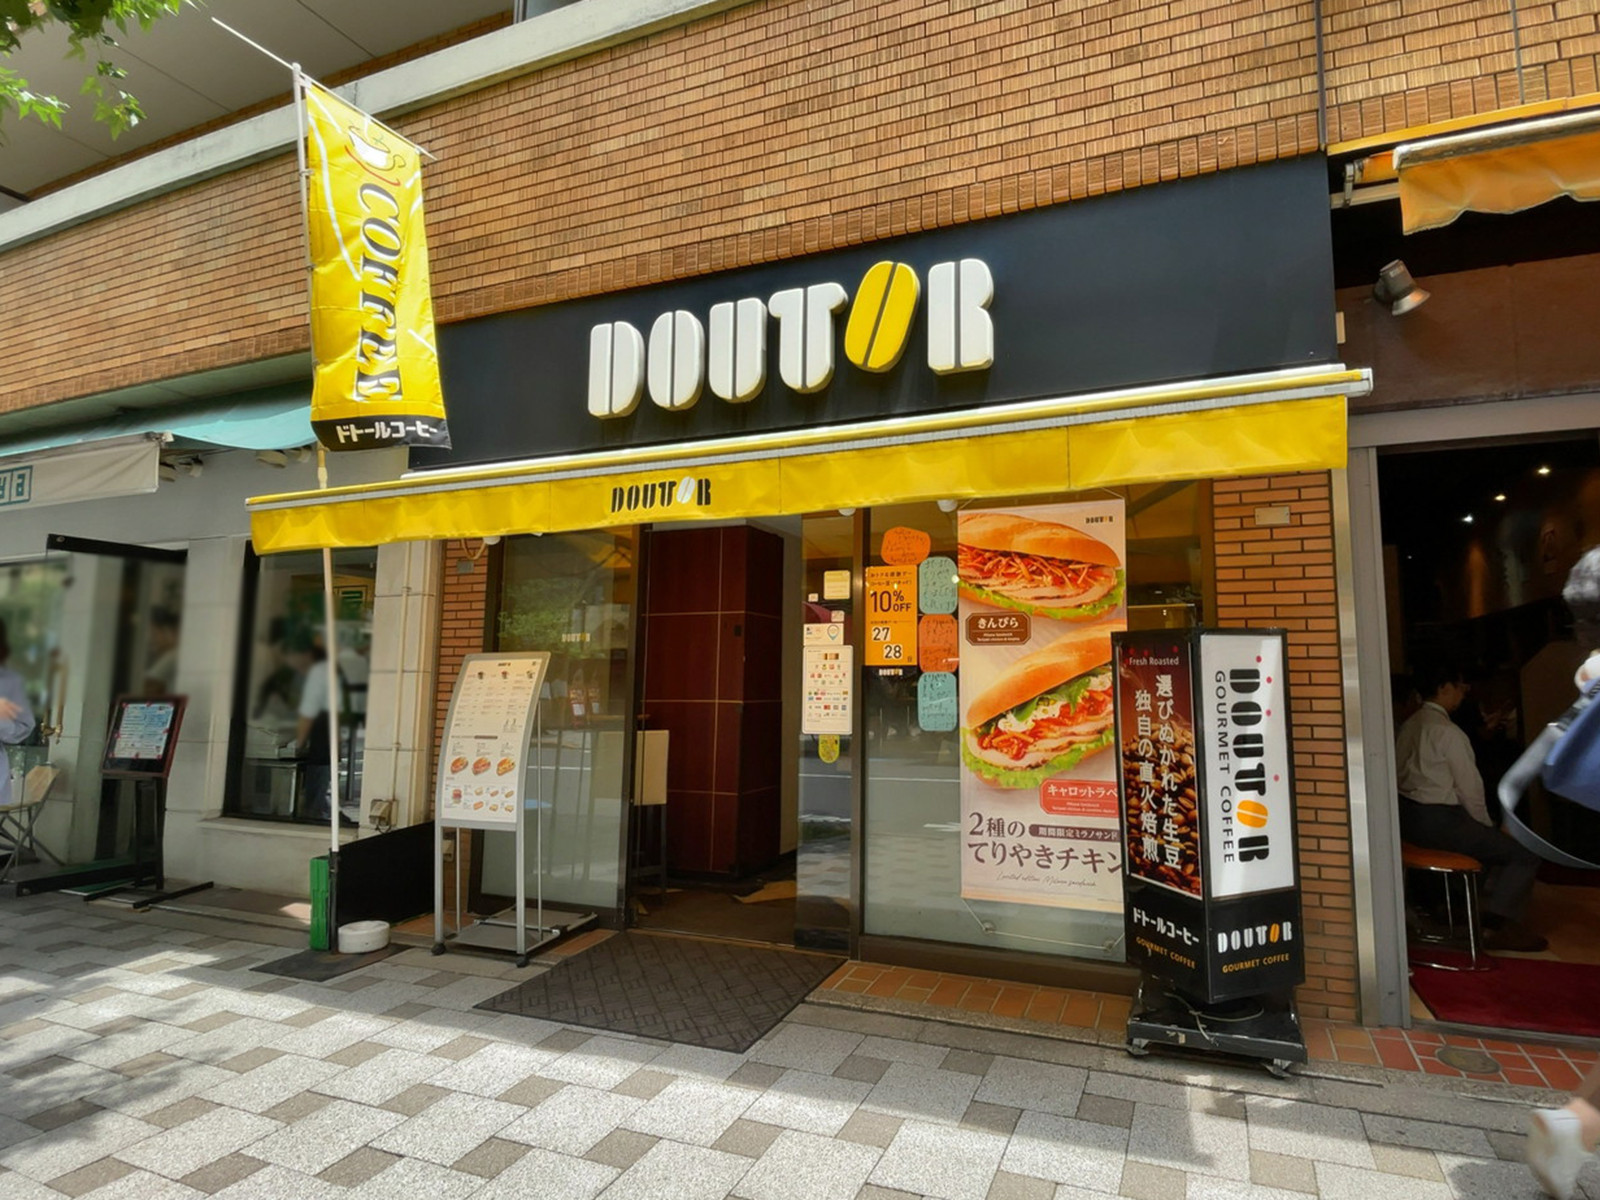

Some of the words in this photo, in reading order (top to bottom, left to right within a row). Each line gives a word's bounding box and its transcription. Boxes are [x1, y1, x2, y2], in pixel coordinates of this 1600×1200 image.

[355, 183, 404, 402] COFFEE
[588, 258, 995, 419] DOUTOR
[335, 420, 439, 444] ドトールコーヒー
[611, 476, 712, 513] DOUTOR
[893, 603, 912, 612] OFF
[977, 616, 1019, 629] きんぴら
[873, 627, 890, 641] 27
[884, 644, 902, 659] 28
[1129, 656, 1148, 666] Fresh
[1149, 656, 1180, 666] Roasted
[1215, 670, 1230, 774] GOURMET
[1134, 689, 1160, 863] 独自の直火焙煎
[1155, 674, 1182, 869] 選びぬかれた生豆
[1229, 668, 1270, 863] DOUTOR
[968, 812, 1026, 839] 2種の
[1220, 786, 1234, 863] COFFEE
[967, 841, 1123, 874] てりやきチキン
[1133, 907, 1200, 946] ドトールコーヒー
[1217, 921, 1293, 954] DOUTOR
[1135, 936, 1167, 957] GOURMET
[1170, 949, 1196, 969] COFFEE
[1222, 958, 1260, 974] GOURMET
[1262, 953, 1290, 966] COFFEE
